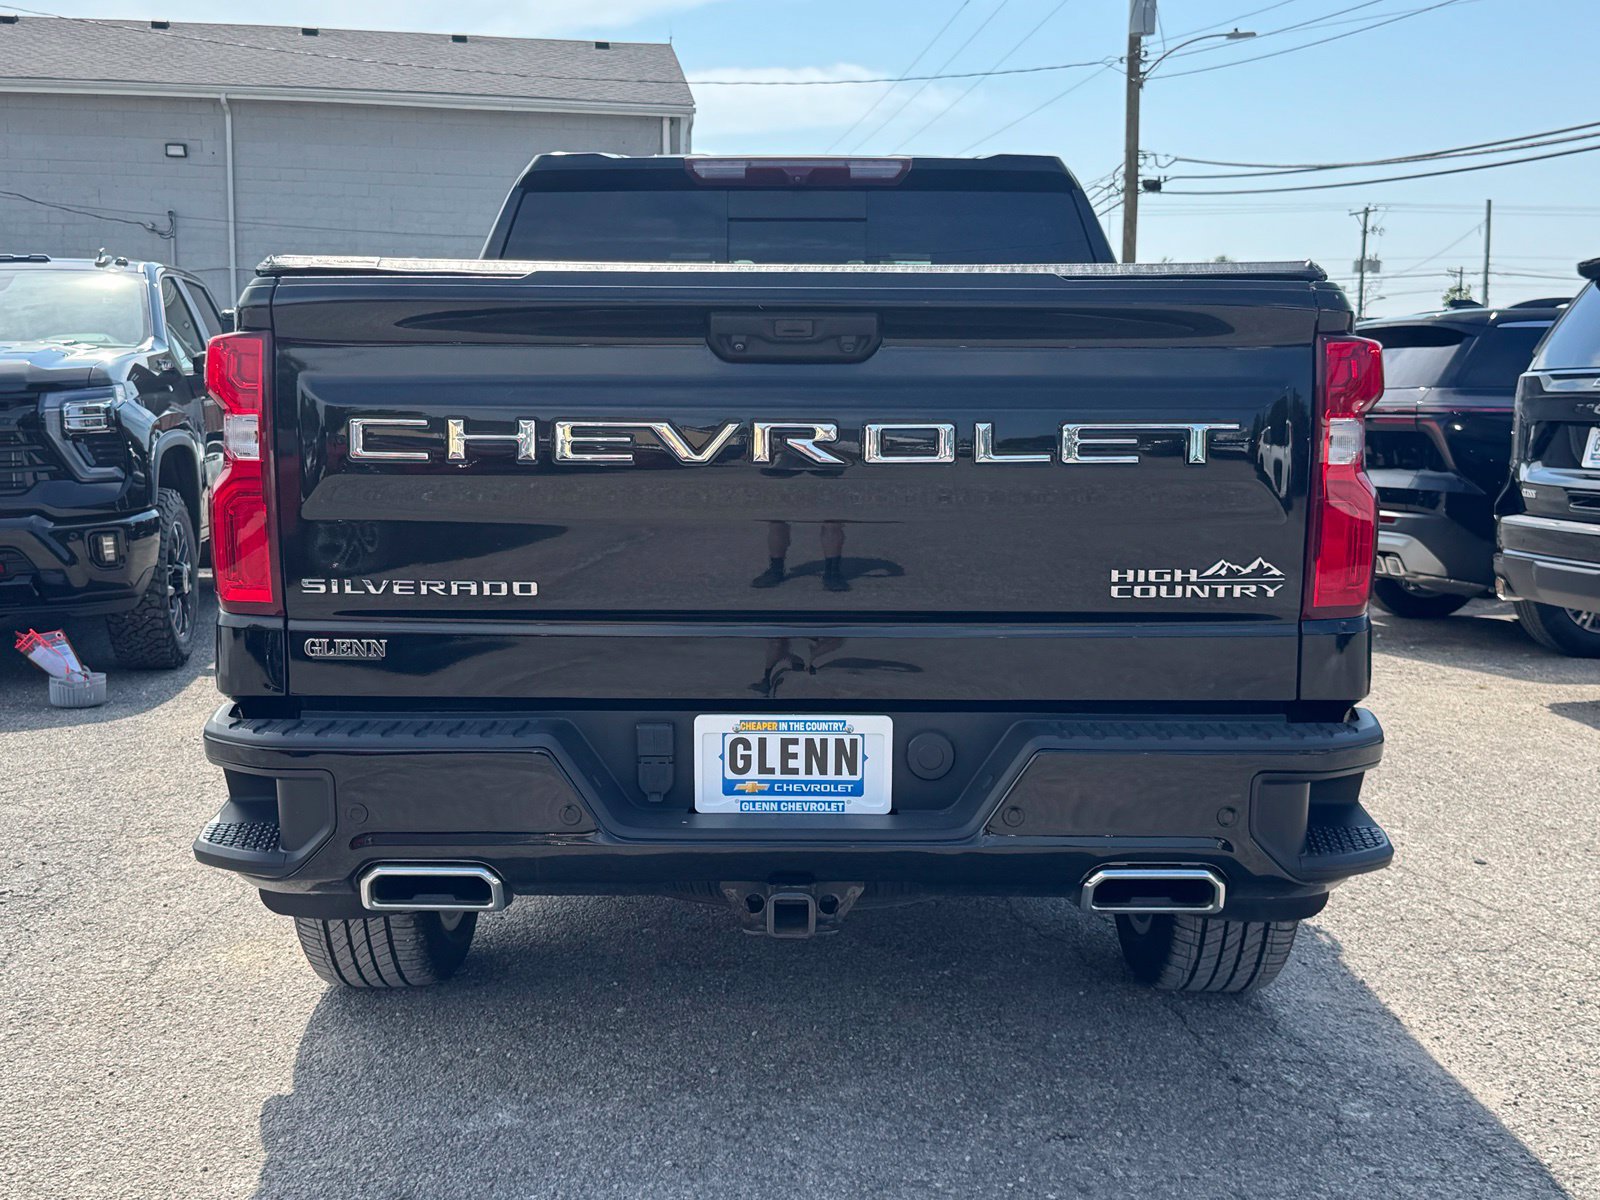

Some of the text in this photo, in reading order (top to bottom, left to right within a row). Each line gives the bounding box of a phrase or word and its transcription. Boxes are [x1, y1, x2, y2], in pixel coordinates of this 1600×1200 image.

[347, 417, 1241, 465] CHEVROLET
[1110, 568, 1199, 583] HIGH
[300, 578, 538, 597] SILVERADO
[1110, 584, 1284, 599] COUNTRY
[303, 637, 388, 657] GLENN
[740, 721, 778, 731] CHEAPER
[779, 721, 788, 731] IN
[789, 721, 805, 731] THE
[728, 736, 859, 777] GLENN
[774, 783, 854, 793] CHEVROLET
[741, 801, 845, 812] GLENN CHEVROLET
